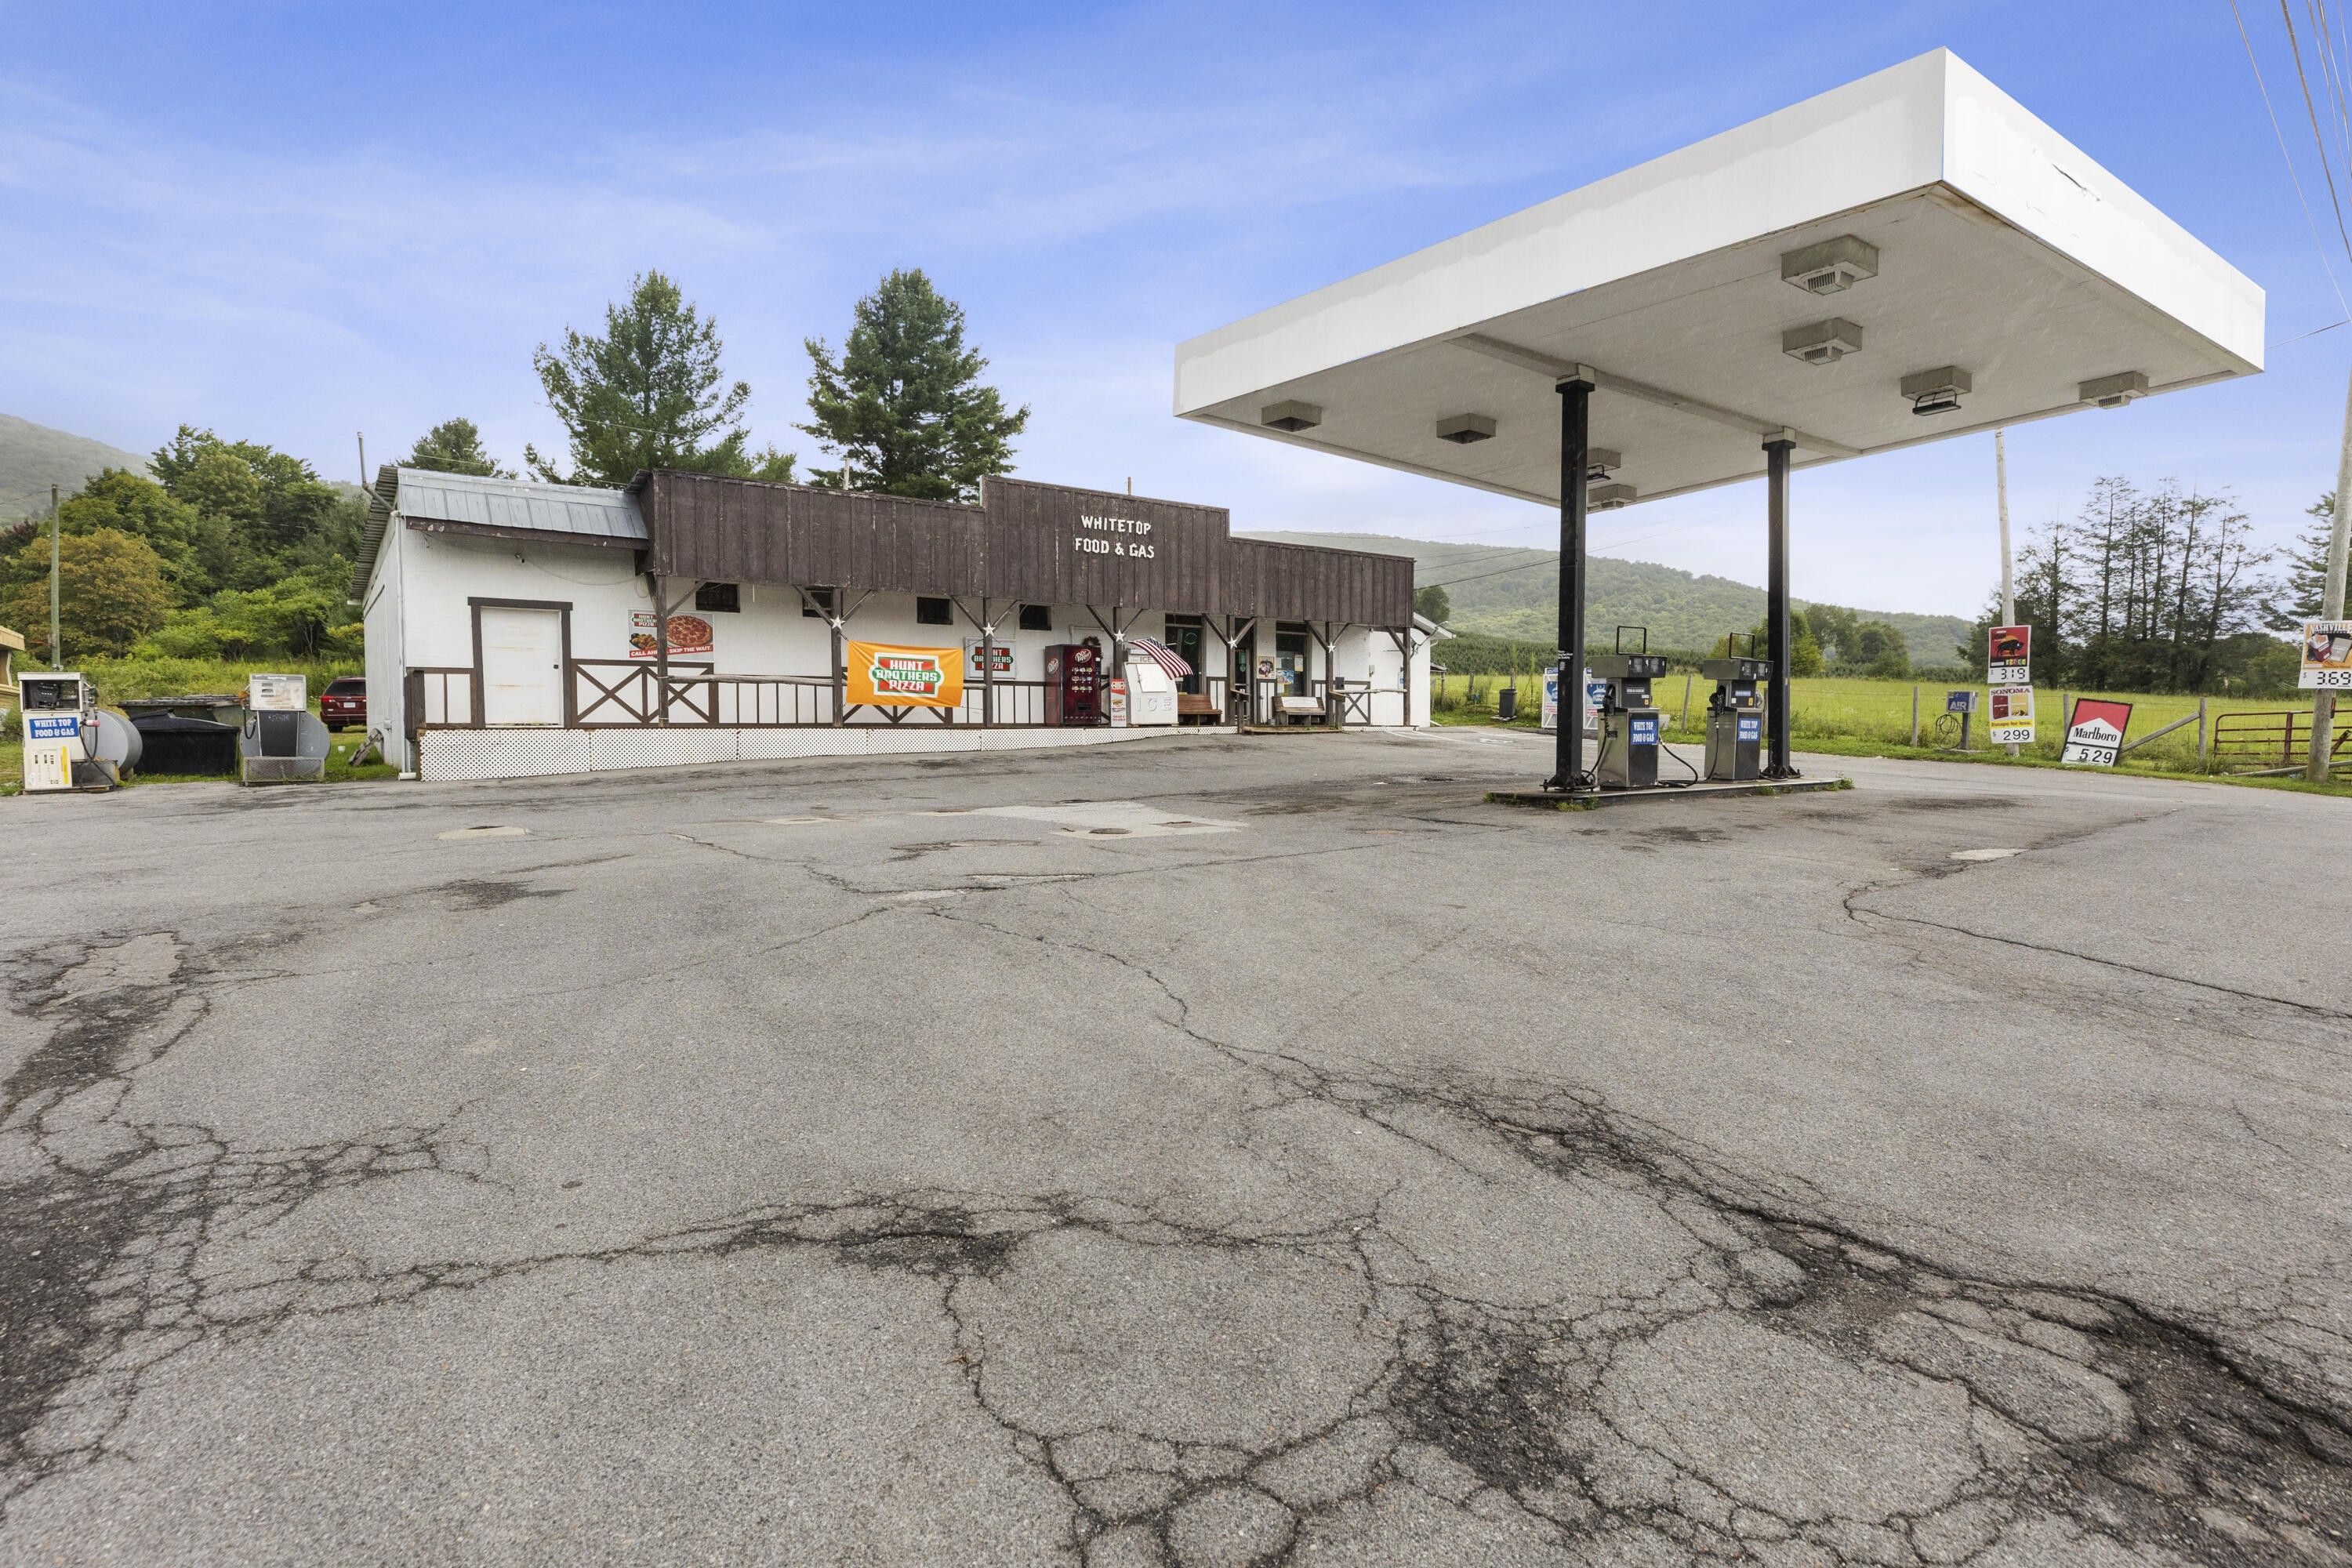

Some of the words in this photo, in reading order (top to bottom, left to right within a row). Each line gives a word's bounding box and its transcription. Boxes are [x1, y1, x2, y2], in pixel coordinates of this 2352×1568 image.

[1081, 515, 1151, 535] WHITETOP
[1075, 538, 1109, 554] FOOD
[1115, 542, 1124, 556] &
[1129, 543, 1155, 558] GAS
[890, 660, 924, 670] HUNT
[876, 670, 938, 681] BROTHERS
[889, 681, 924, 691] PIZZA
[1135, 697, 1172, 712] ICE
[1950, 701, 1967, 710] AIR
[34, 719, 57, 728] WHITE
[1633, 722, 1646, 731] WHITE
[1633, 734, 1643, 742] FOOD
[2073, 727, 2117, 742] Marlboro
